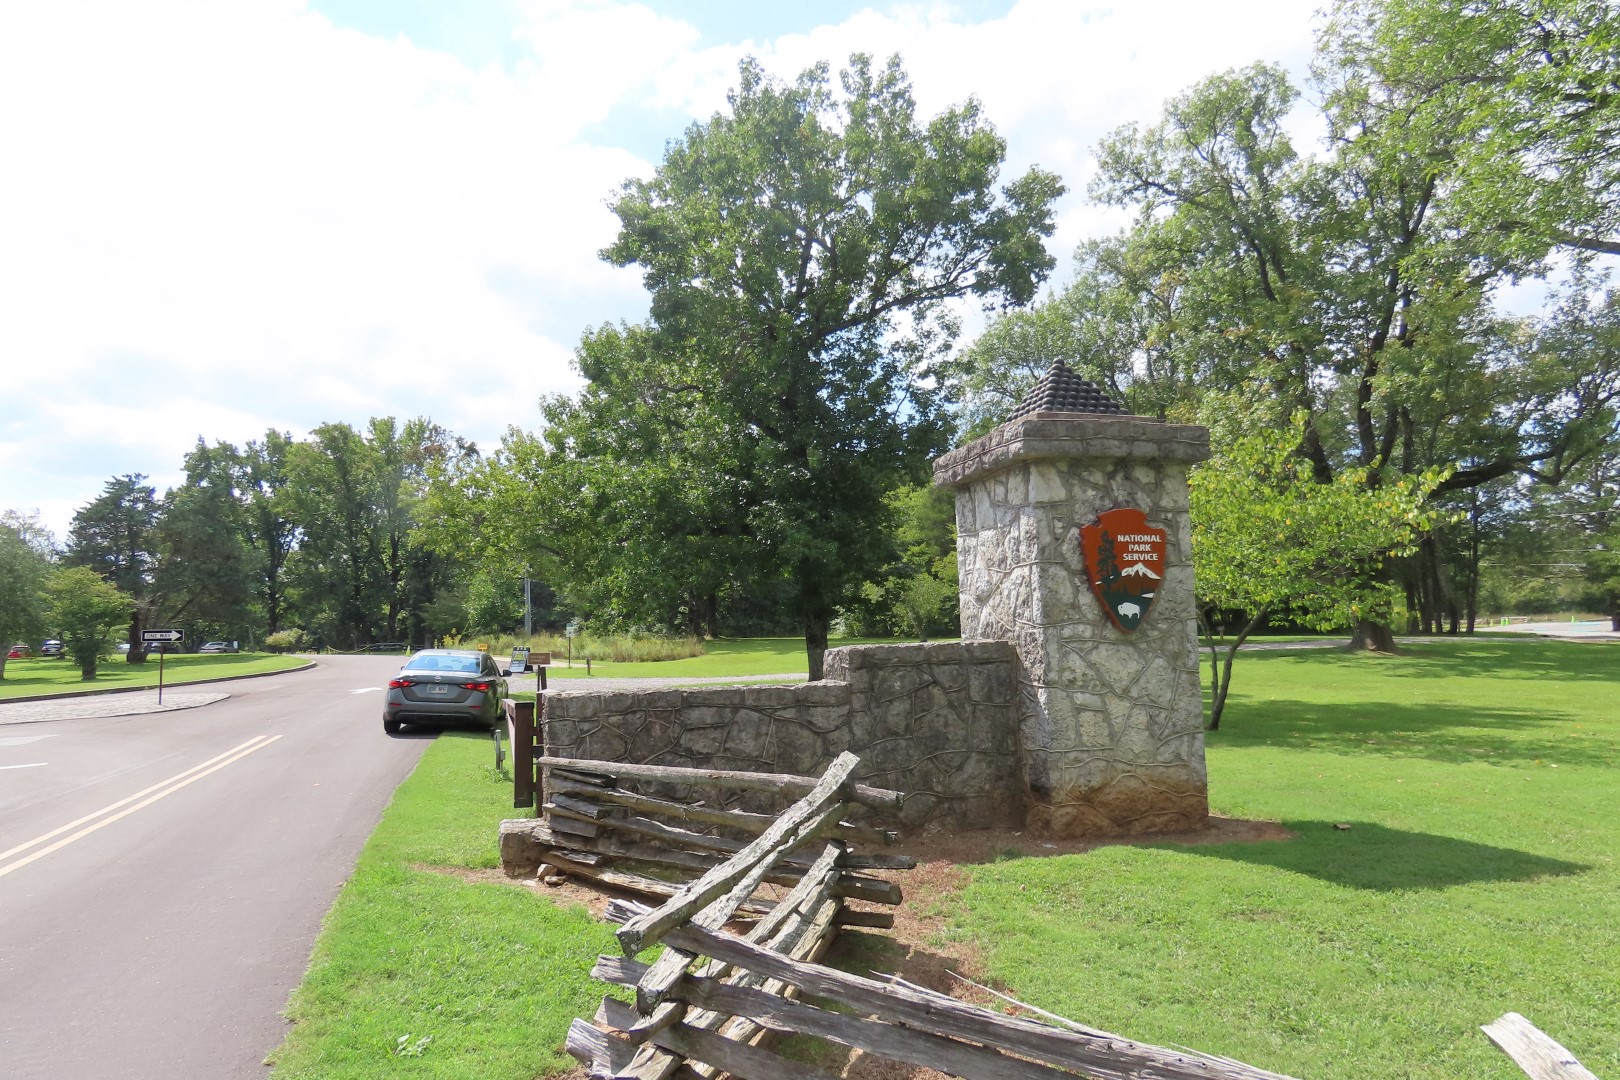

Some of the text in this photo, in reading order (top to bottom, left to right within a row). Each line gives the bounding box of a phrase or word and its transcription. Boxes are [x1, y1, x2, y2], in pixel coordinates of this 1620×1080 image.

[1117, 534, 1162, 543] NATIONAL
[1128, 544, 1152, 552] PARK
[1122, 553, 1159, 561] SERVICE
